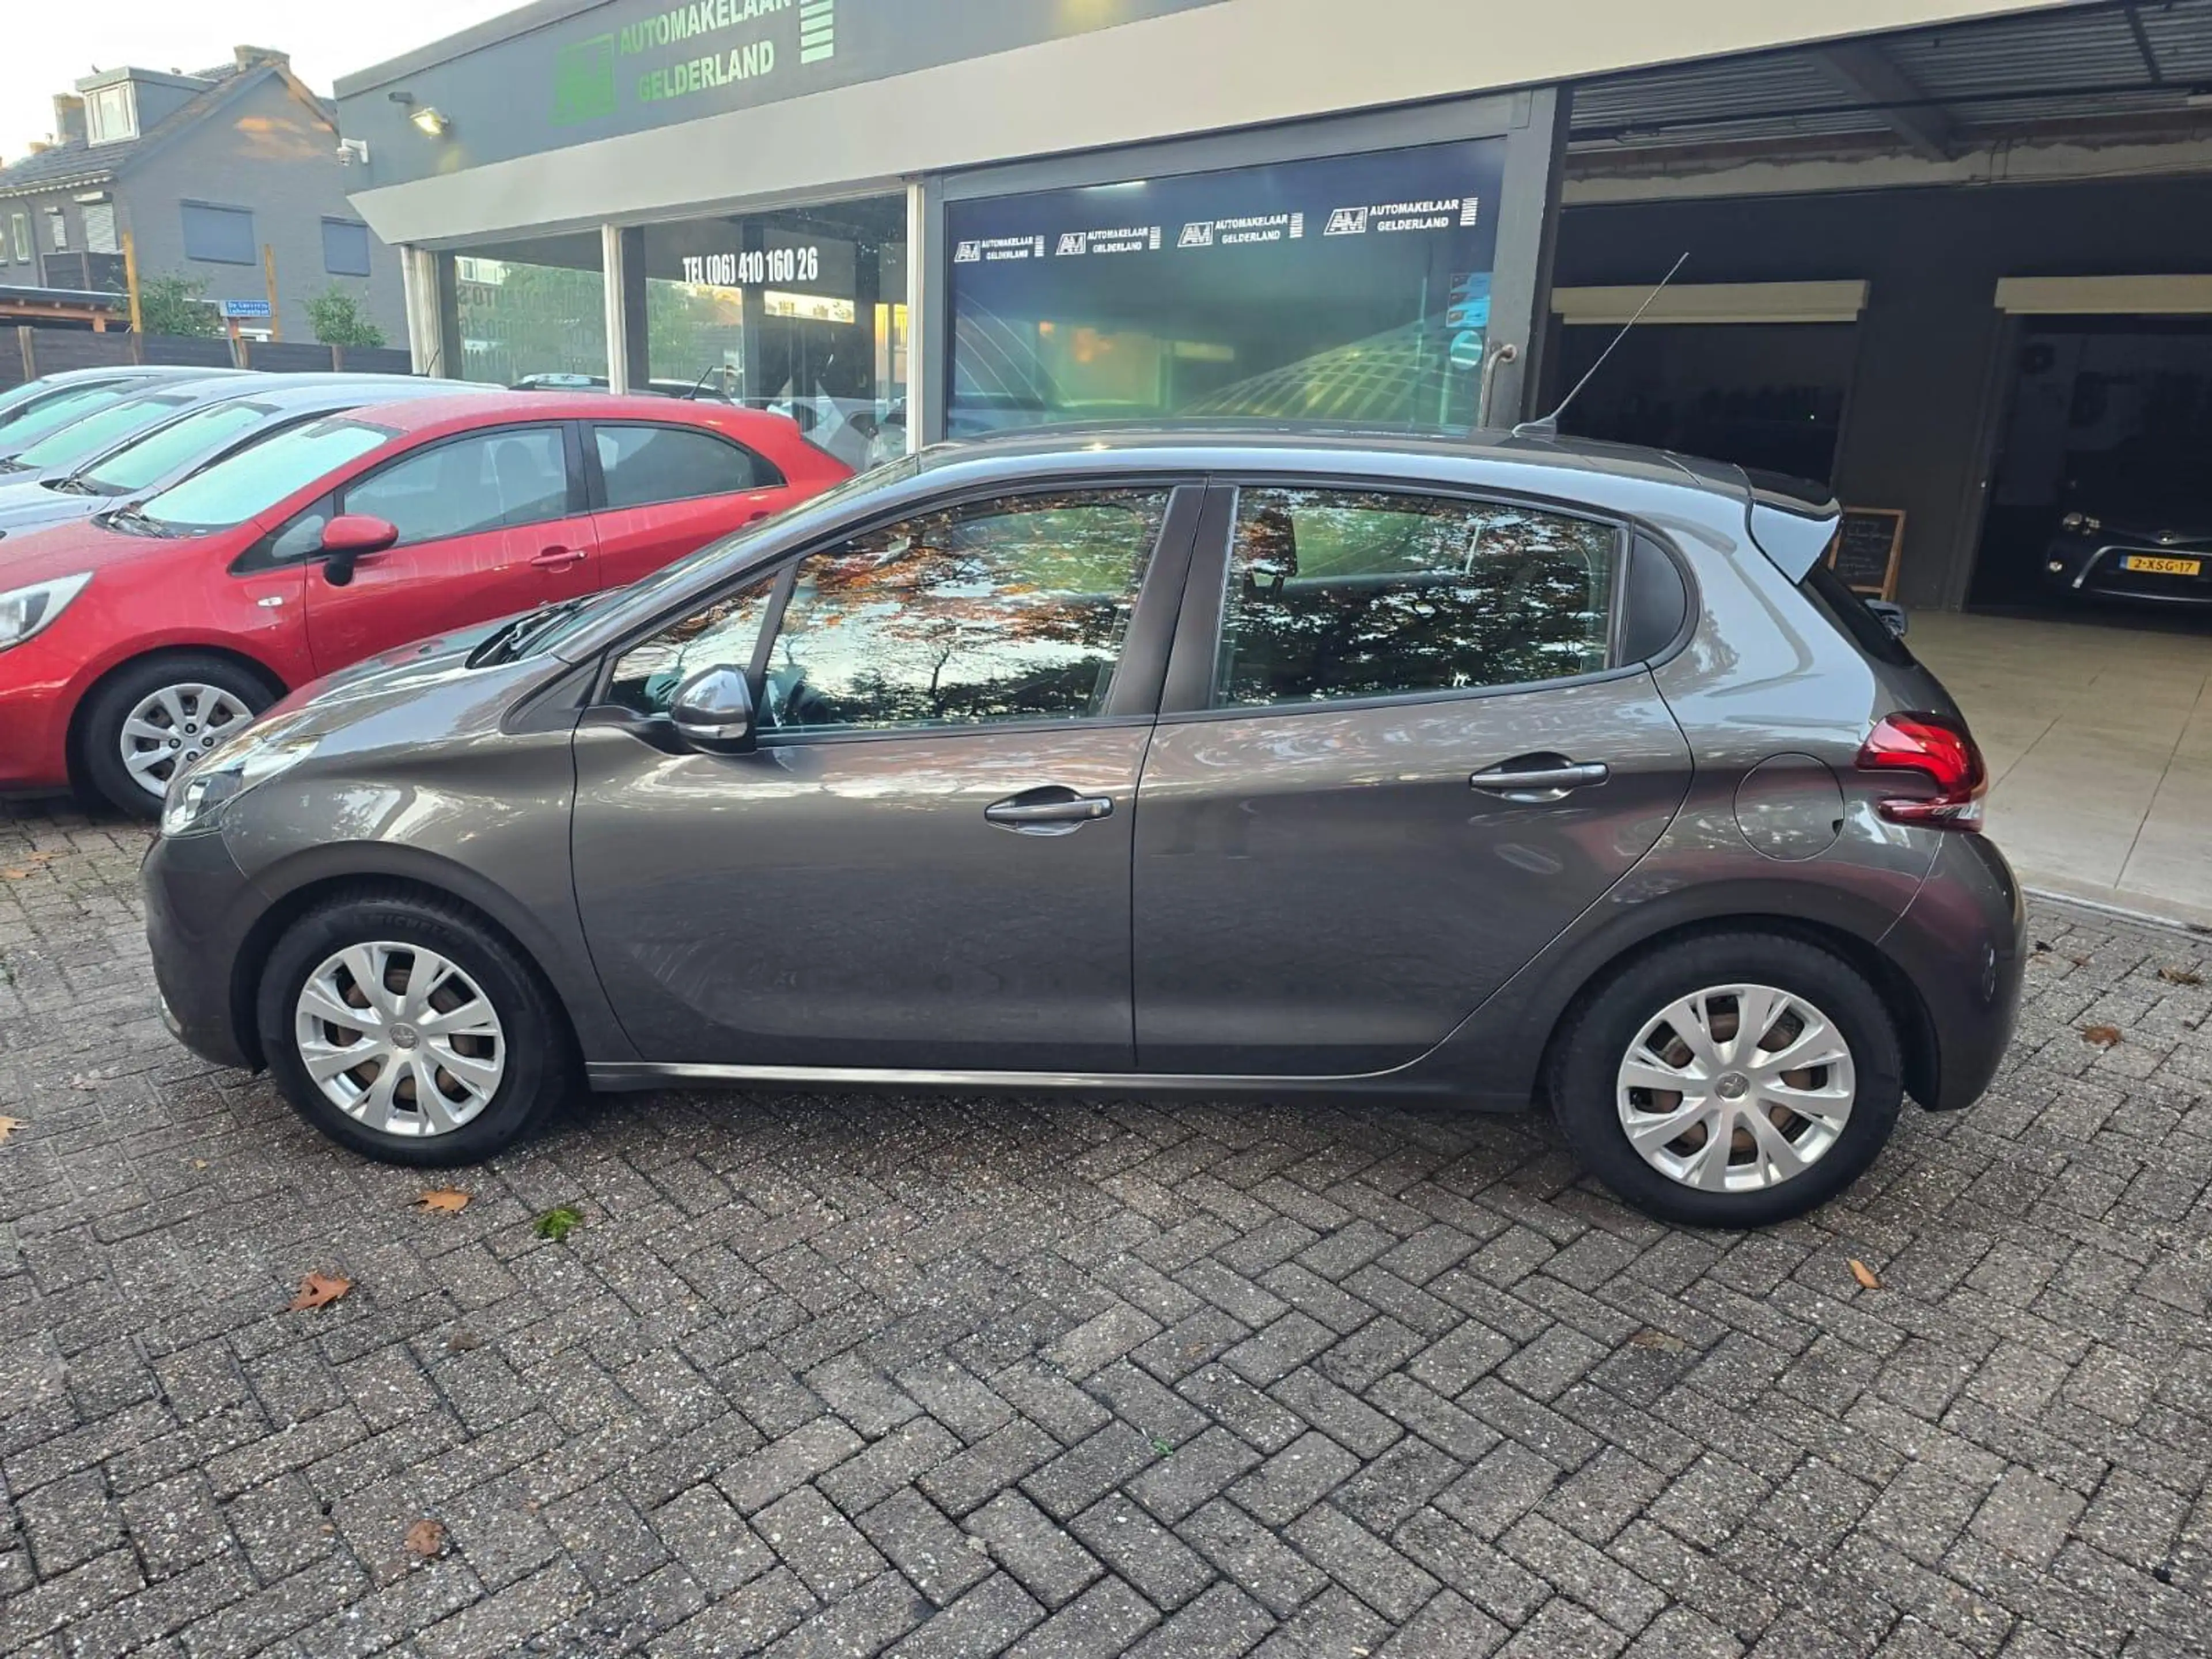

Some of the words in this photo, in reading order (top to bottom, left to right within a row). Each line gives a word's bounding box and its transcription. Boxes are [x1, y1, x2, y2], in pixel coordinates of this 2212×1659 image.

[639, 40, 774, 102] GELDERLAND
[1369, 199, 1459, 217] AUTOMAKELAAR
[1215, 214, 1287, 230] AUTOMAKELAAR
[1377, 217, 1449, 231] GELDERLAND
[1221, 230, 1281, 244] GELDERLAND
[706, 253, 735, 285] (06)
[738, 251, 763, 283] 410
[766, 248, 794, 282] 160
[797, 246, 818, 281] 26
